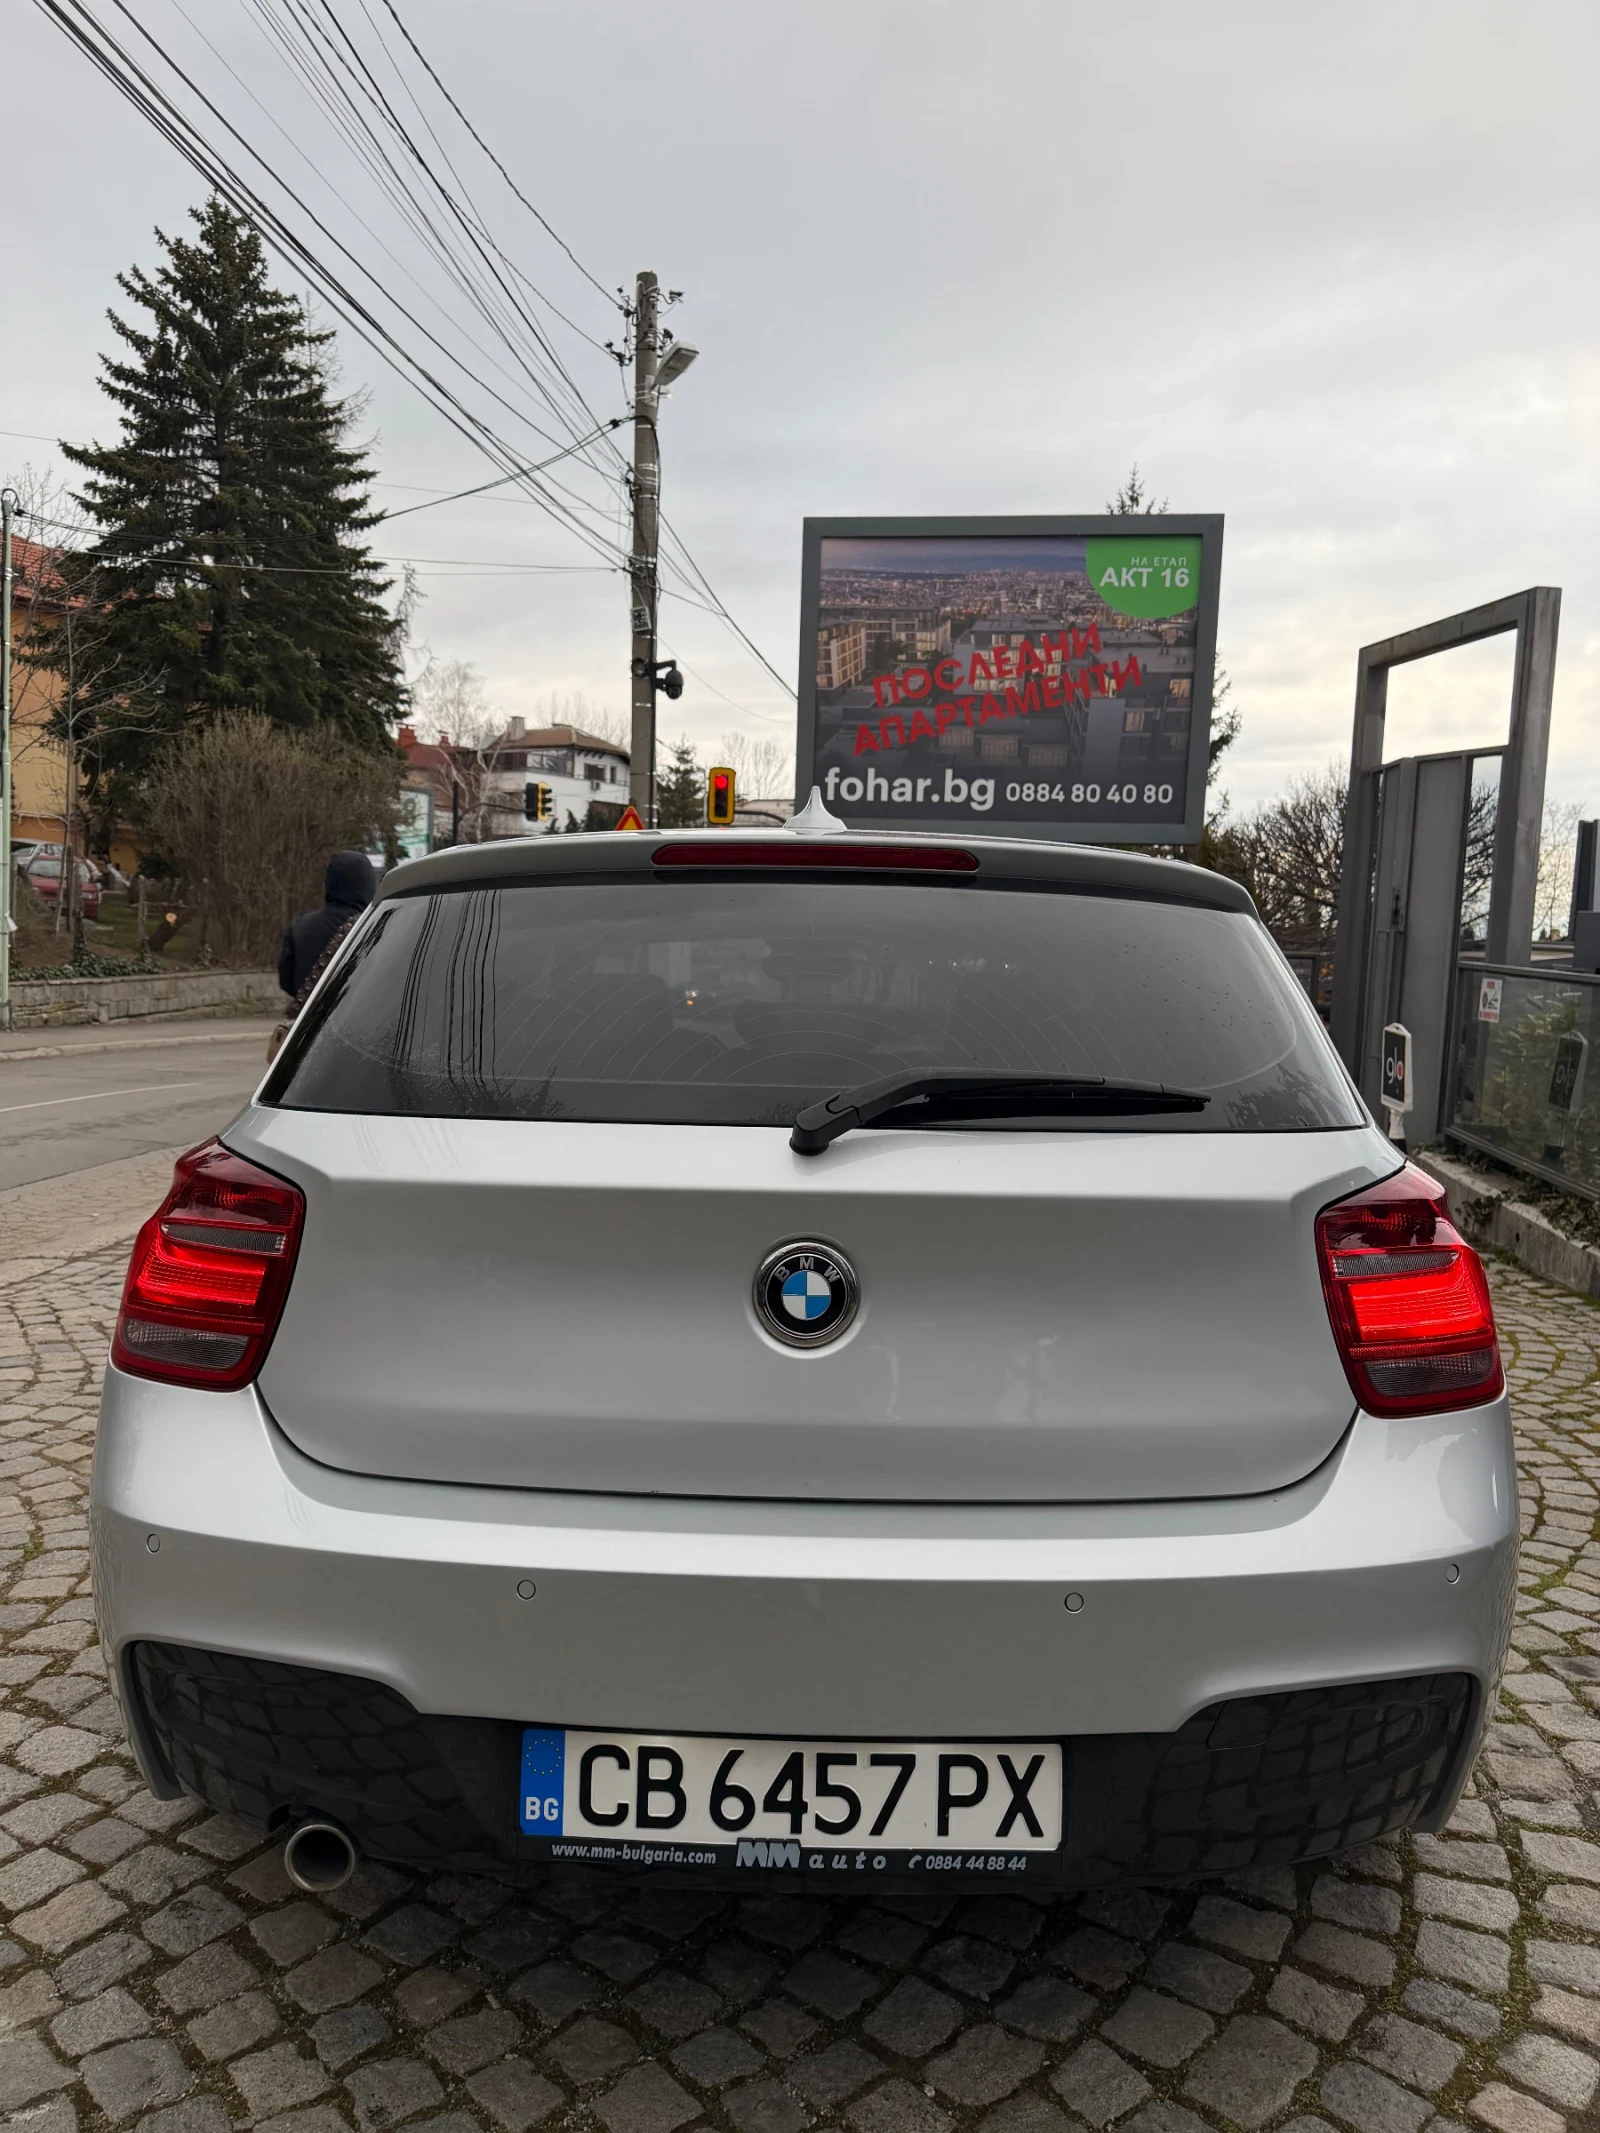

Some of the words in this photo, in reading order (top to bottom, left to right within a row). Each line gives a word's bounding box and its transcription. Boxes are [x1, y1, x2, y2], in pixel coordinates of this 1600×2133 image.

[1131, 556, 1148, 566] НА
[1153, 557, 1187, 567] ЕТАП
[1099, 566, 1153, 588] АКТ
[1161, 567, 1190, 588] 16
[872, 622, 1102, 708] ПОСЛЕДНИ
[853, 655, 1143, 757] АПАРТАМЕНТИ
[824, 766, 996, 811] fohar.bg
[1005, 782, 1065, 803] 0884
[1071, 783, 1101, 803] 80
[1106, 783, 1138, 804] 40
[1143, 784, 1174, 804] 80
[774, 1256, 841, 1284] BMW
[579, 1744, 687, 1829] CB
[708, 1749, 916, 1836] 6457
[937, 1753, 1046, 1837] PX
[525, 1796, 559, 1821] BG
[551, 1843, 717, 1865] www.mm-bulgaria.com
[735, 1841, 801, 1869] MM
[808, 1851, 887, 1870] auto
[925, 1855, 962, 1870] 0884
[966, 1855, 985, 1871] 44
[987, 1855, 1006, 1871] 88
[1008, 1856, 1027, 1871] 44
